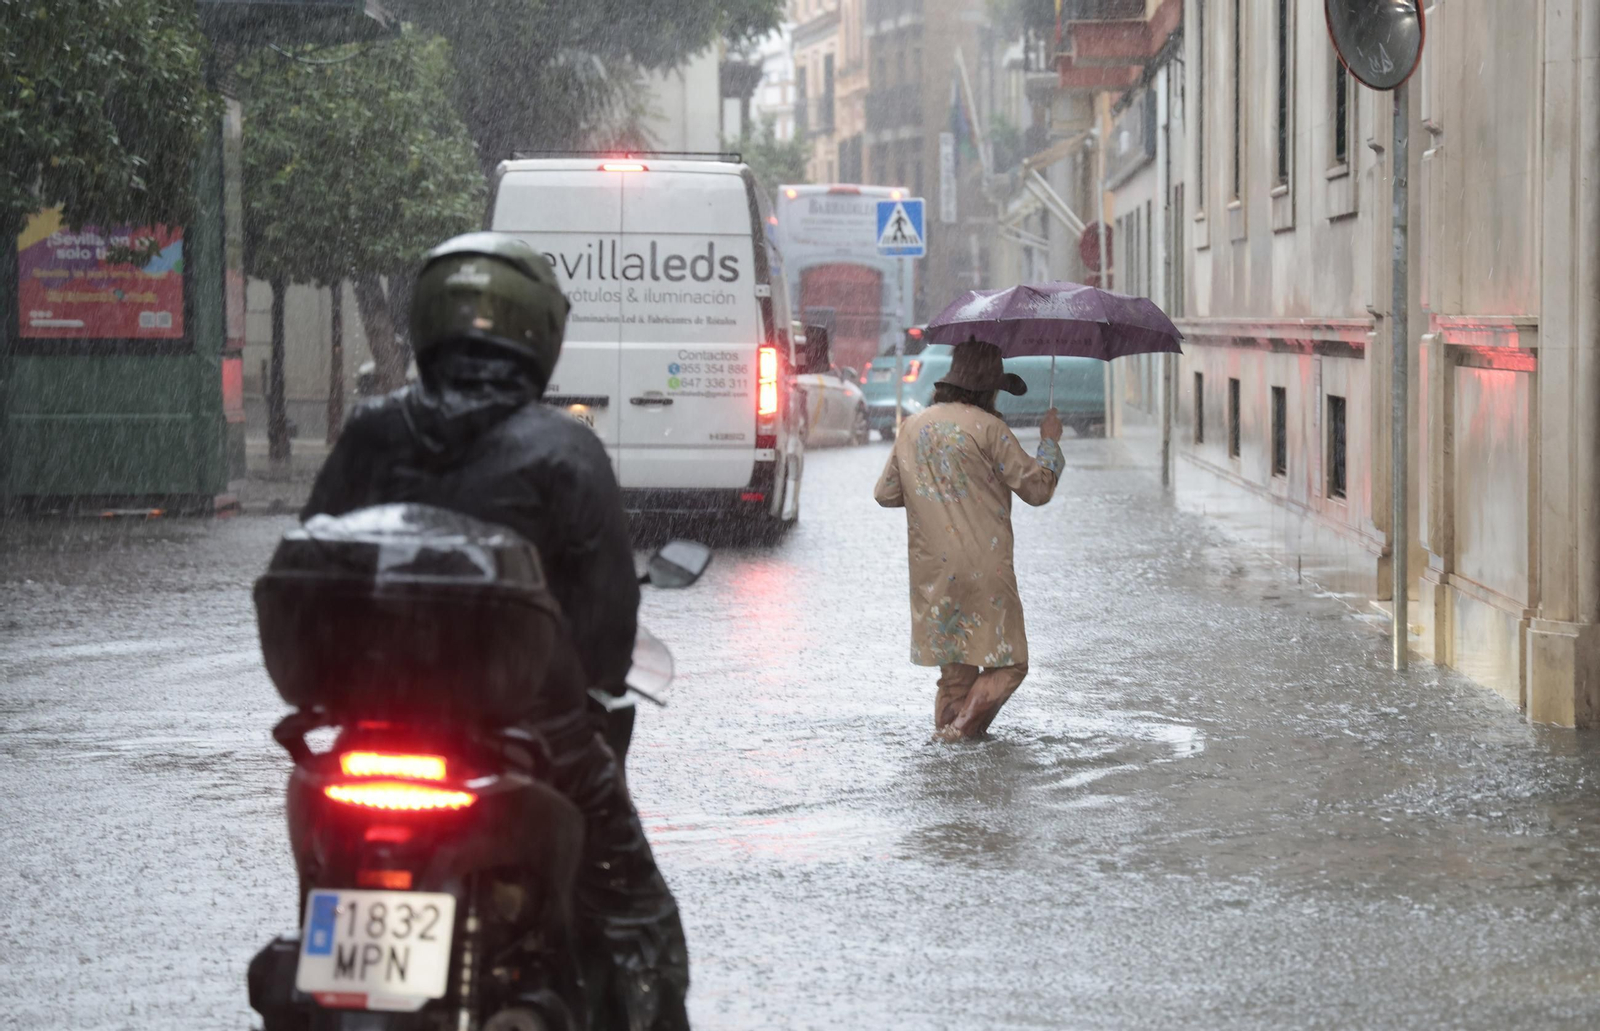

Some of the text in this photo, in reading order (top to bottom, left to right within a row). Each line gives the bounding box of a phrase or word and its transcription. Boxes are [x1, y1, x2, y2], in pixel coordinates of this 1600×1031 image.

[56, 248, 91, 260] solo
[515, 238, 739, 283] villaleds
[567, 287, 736, 305] rótulos & iluminación
[678, 349, 739, 361] Contactos
[680, 363, 701, 375] 955
[704, 363, 724, 375] 354
[680, 377, 748, 389] 647 336 311
[346, 901, 440, 942] 1832
[333, 943, 411, 982] MPN
